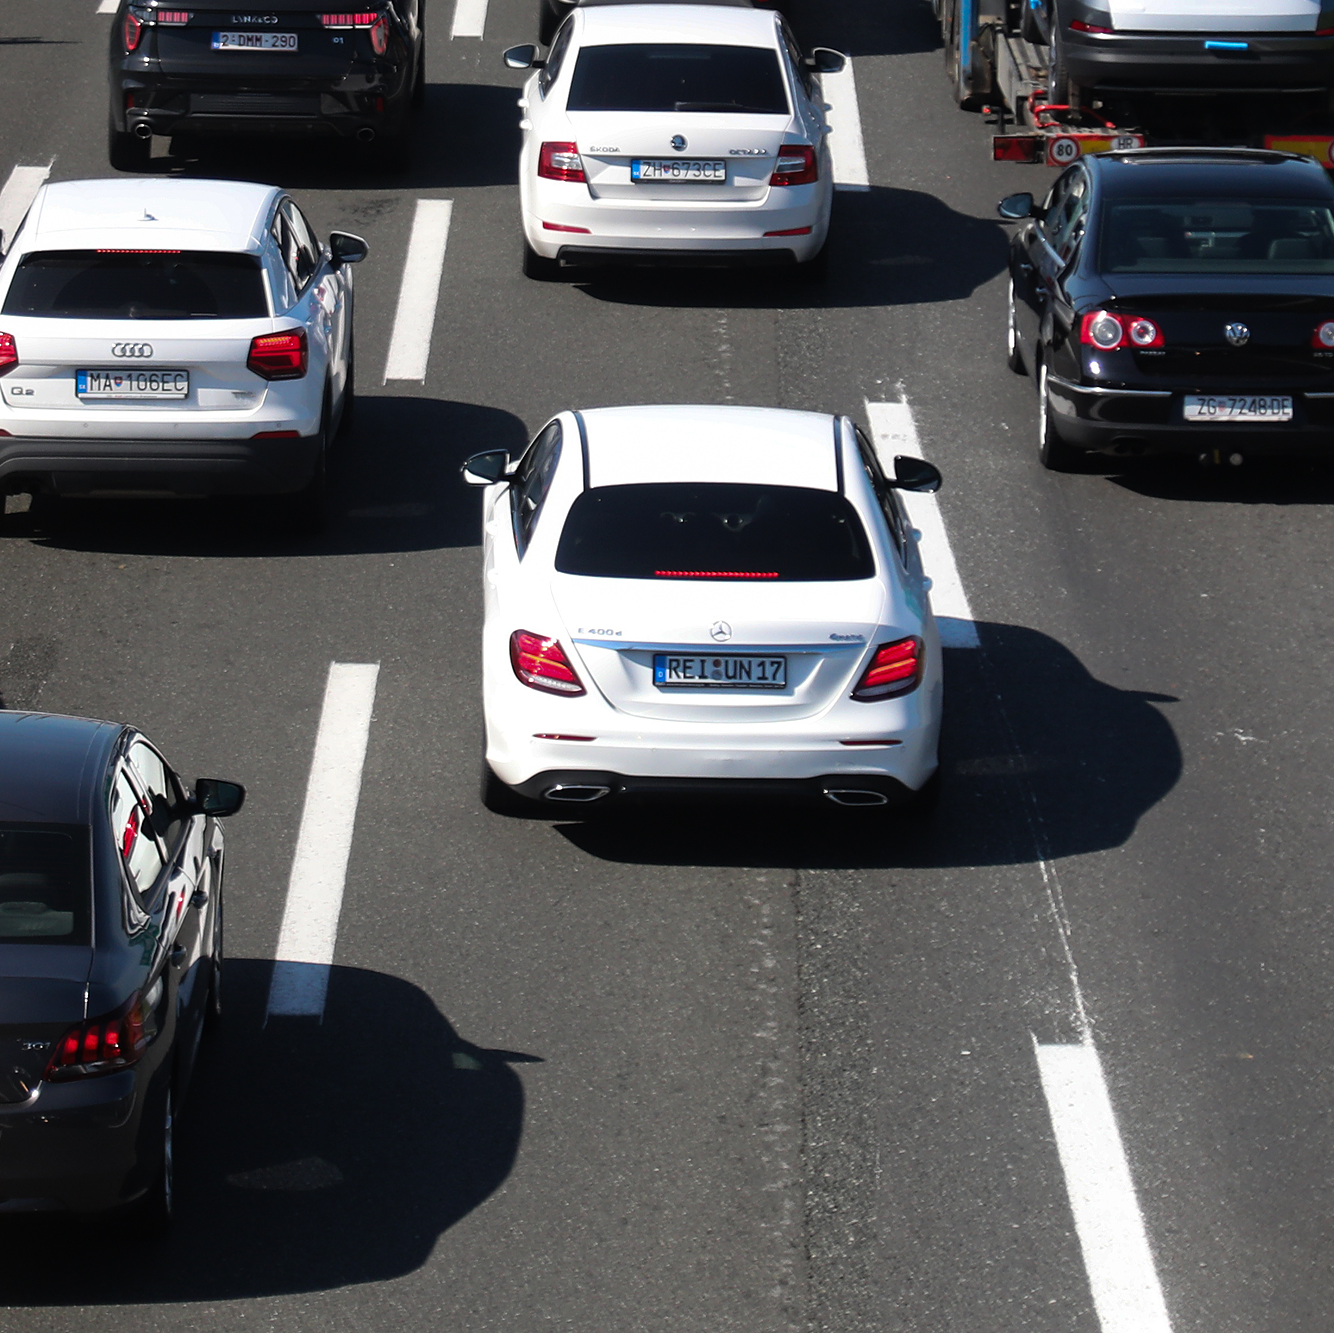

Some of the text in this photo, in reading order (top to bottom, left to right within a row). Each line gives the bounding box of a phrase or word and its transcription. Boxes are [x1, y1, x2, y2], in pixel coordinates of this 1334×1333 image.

[1057, 144, 1073, 156] 80
[1118, 138, 1134, 149] HR
[643, 162, 662, 177] ZH
[672, 162, 723, 178] 673CE
[90, 373, 113, 391] MA
[127, 373, 185, 392] 106EC
[11, 386, 34, 397] Q2
[1197, 398, 1217, 415] ZG
[668, 656, 707, 680] REI
[726, 656, 751, 680] UN
[756, 657, 781, 681] 17
